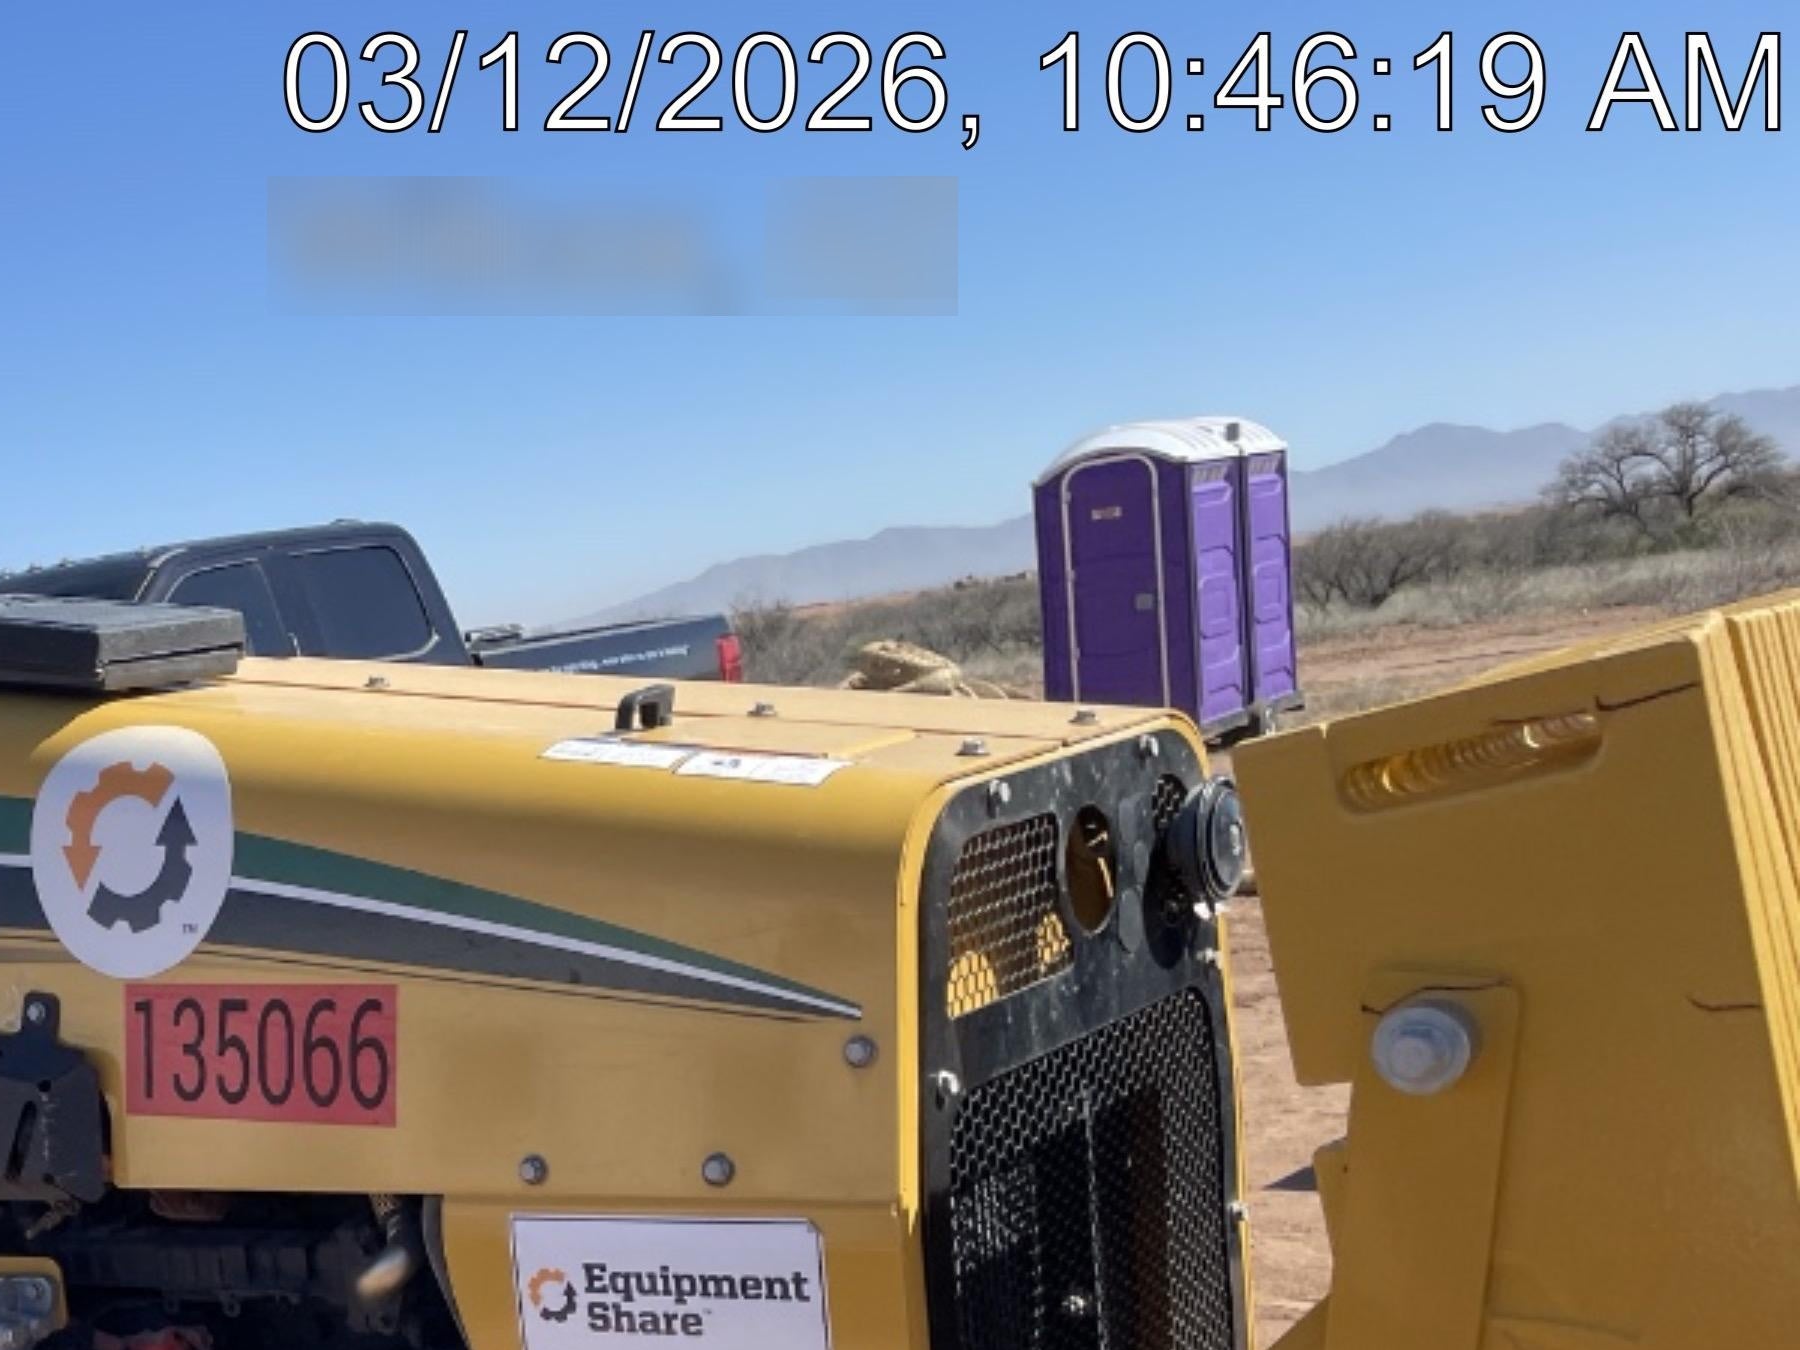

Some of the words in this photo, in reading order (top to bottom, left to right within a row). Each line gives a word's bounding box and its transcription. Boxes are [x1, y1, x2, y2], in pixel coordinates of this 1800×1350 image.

[135, 997, 389, 1110] 135066
[582, 1262, 812, 1304] Equipment
[588, 1301, 703, 1336] Share
